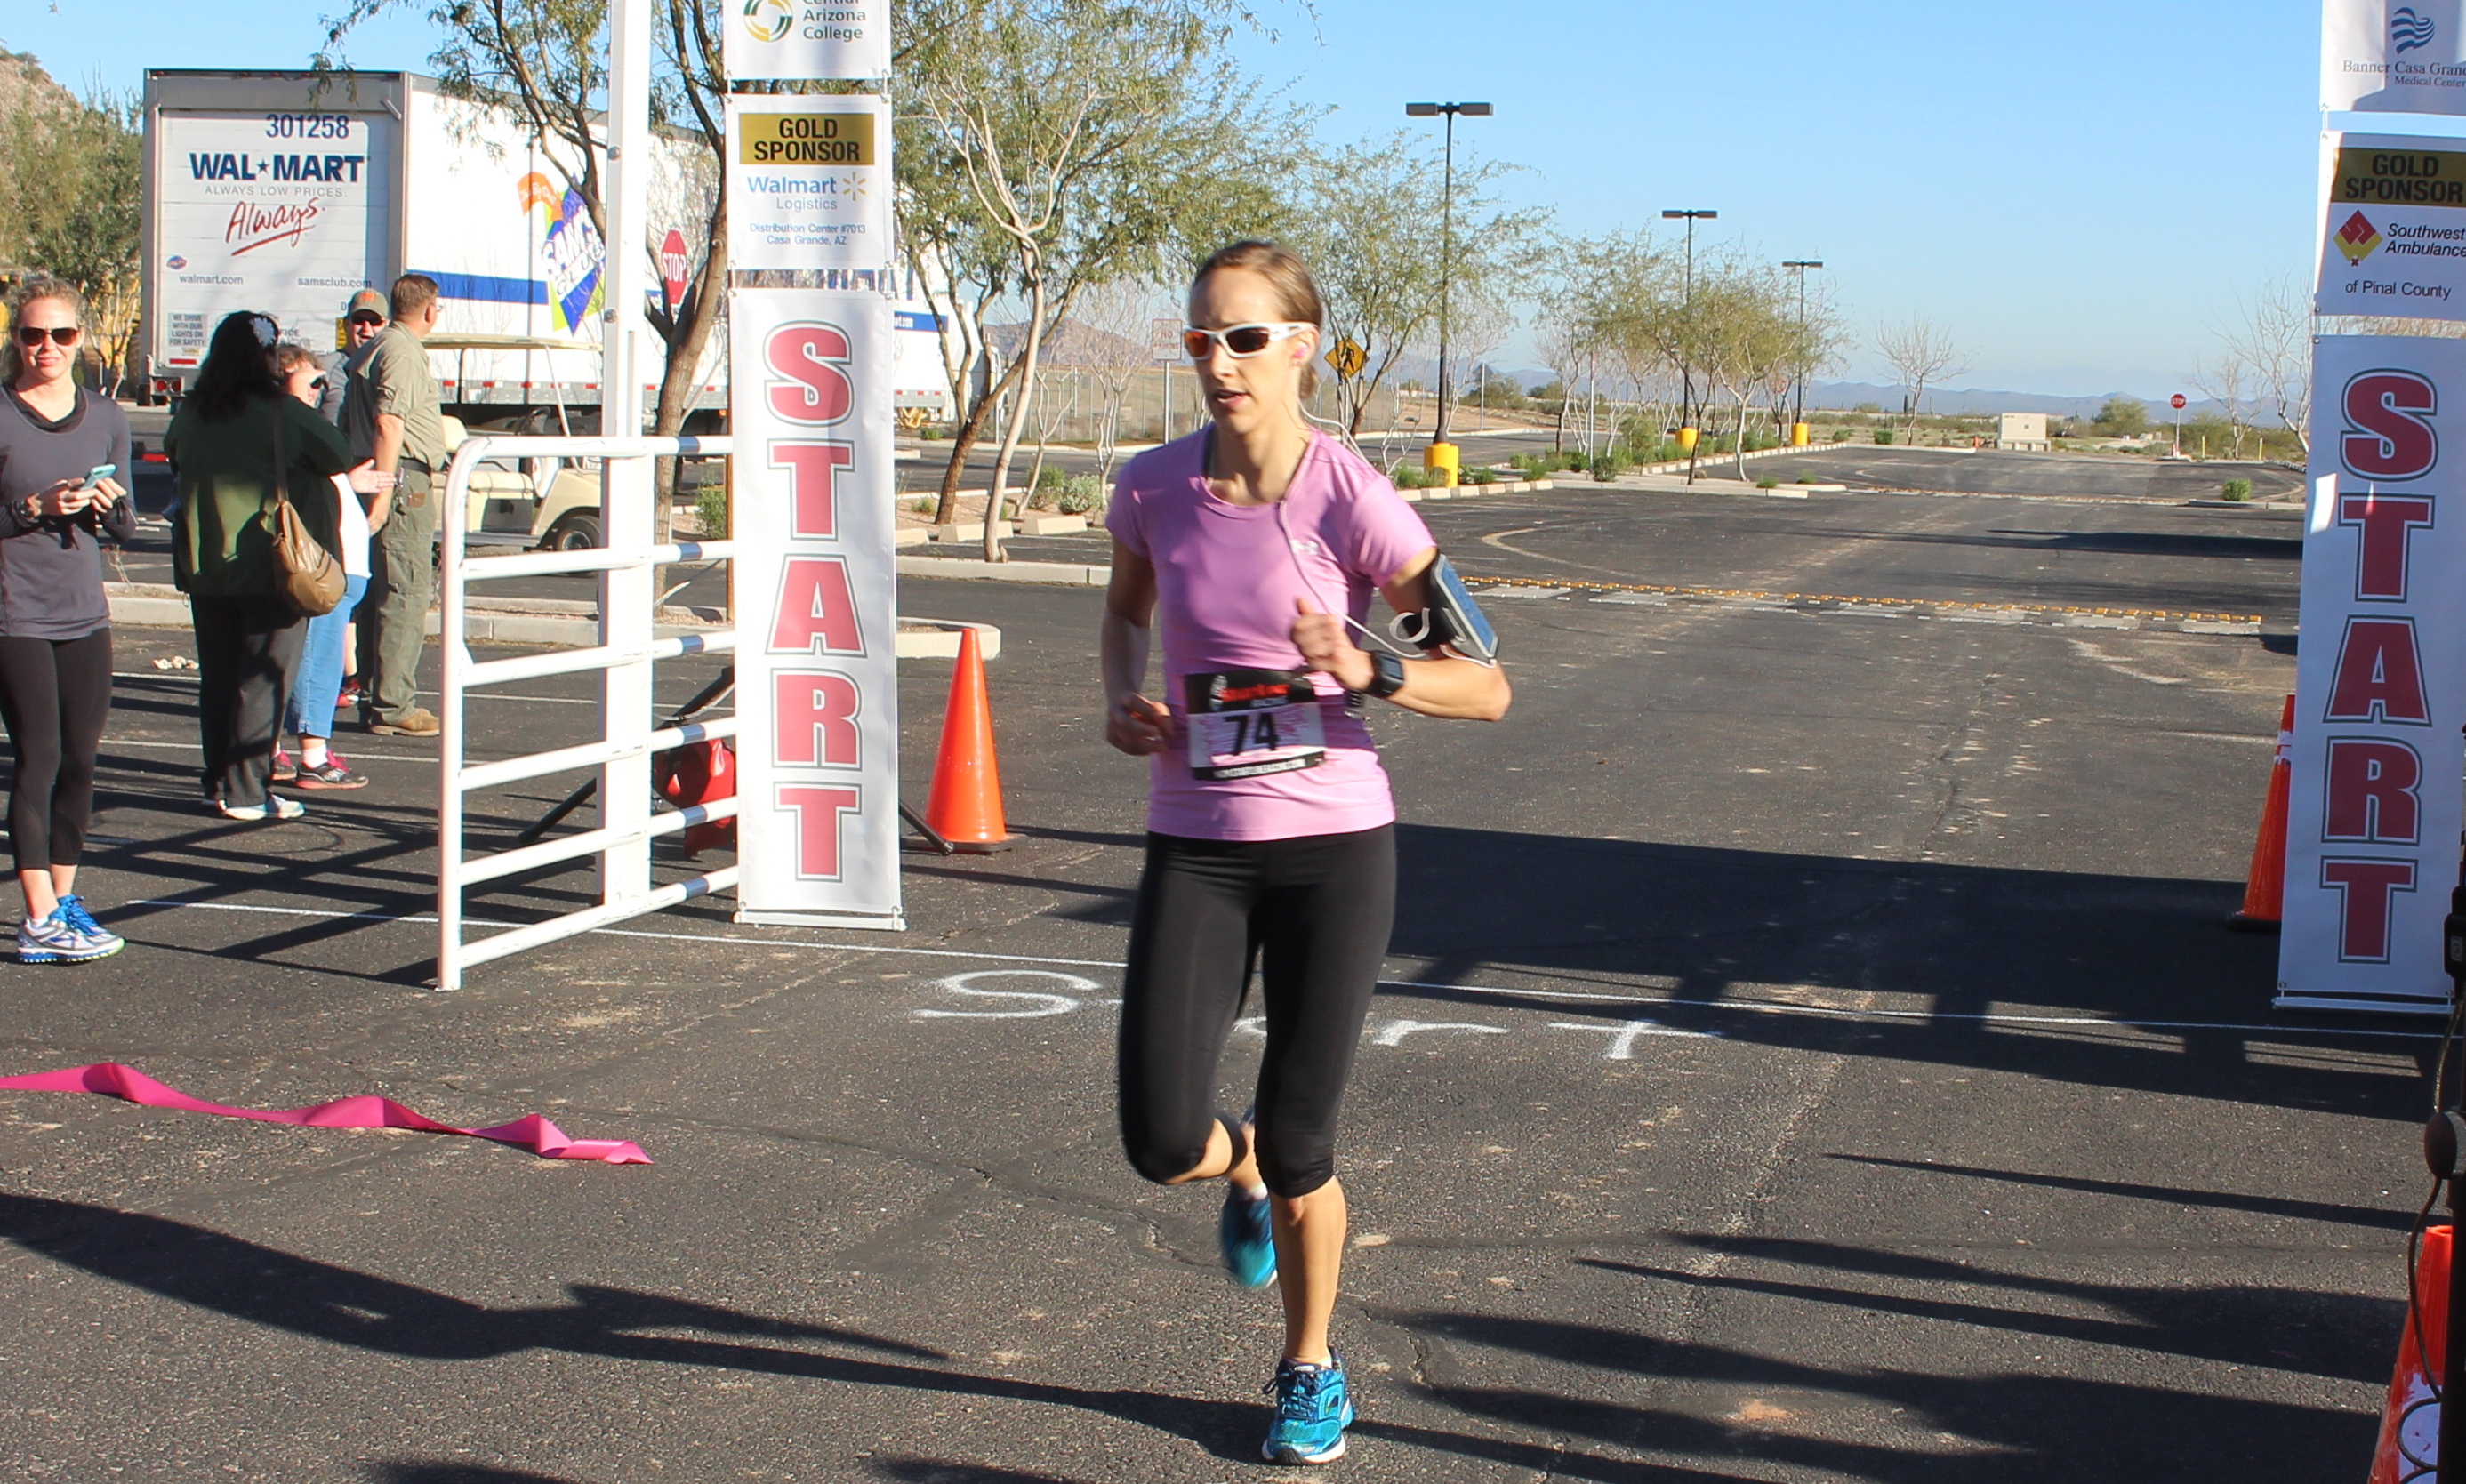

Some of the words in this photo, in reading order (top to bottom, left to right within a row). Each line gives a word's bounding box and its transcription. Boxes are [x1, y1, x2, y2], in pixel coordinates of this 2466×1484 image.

[803, 8, 866, 22] Arizona
[803, 25, 864, 43] College
[2342, 60, 2390, 74] Banner
[2394, 61, 2426, 75] Casa
[2394, 76, 2431, 86] Medical
[2433, 77, 2466, 88] Center
[266, 113, 350, 140] 301258
[779, 117, 838, 139] GOLD
[754, 140, 860, 162] SPONSOR
[2372, 154, 2439, 178] GOLD
[205, 185, 254, 196] ALWAYS
[261, 187, 289, 197] LOW
[747, 176, 837, 194] Walmart
[2345, 177, 2464, 204] SPONSOR
[776, 197, 838, 213] Logistics
[750, 222, 805, 233] Distribution
[808, 223, 838, 234] Center
[2387, 222, 2466, 241] Southwest
[767, 235, 791, 245] Casa
[835, 236, 847, 245] AZ
[2385, 240, 2466, 258] Ambulance
[662, 253, 687, 282] STOP
[179, 275, 245, 285] walmart.com
[297, 277, 373, 288] samsclub.com
[2345, 281, 2358, 293] of
[2362, 280, 2396, 295] Pinal
[2401, 282, 2452, 301] County
[1161, 330, 1173, 339] NO
[2172, 397, 2185, 405] STOP
[763, 320, 868, 883] START
[2320, 368, 2438, 964] START
[1224, 711, 1279, 756] 74
